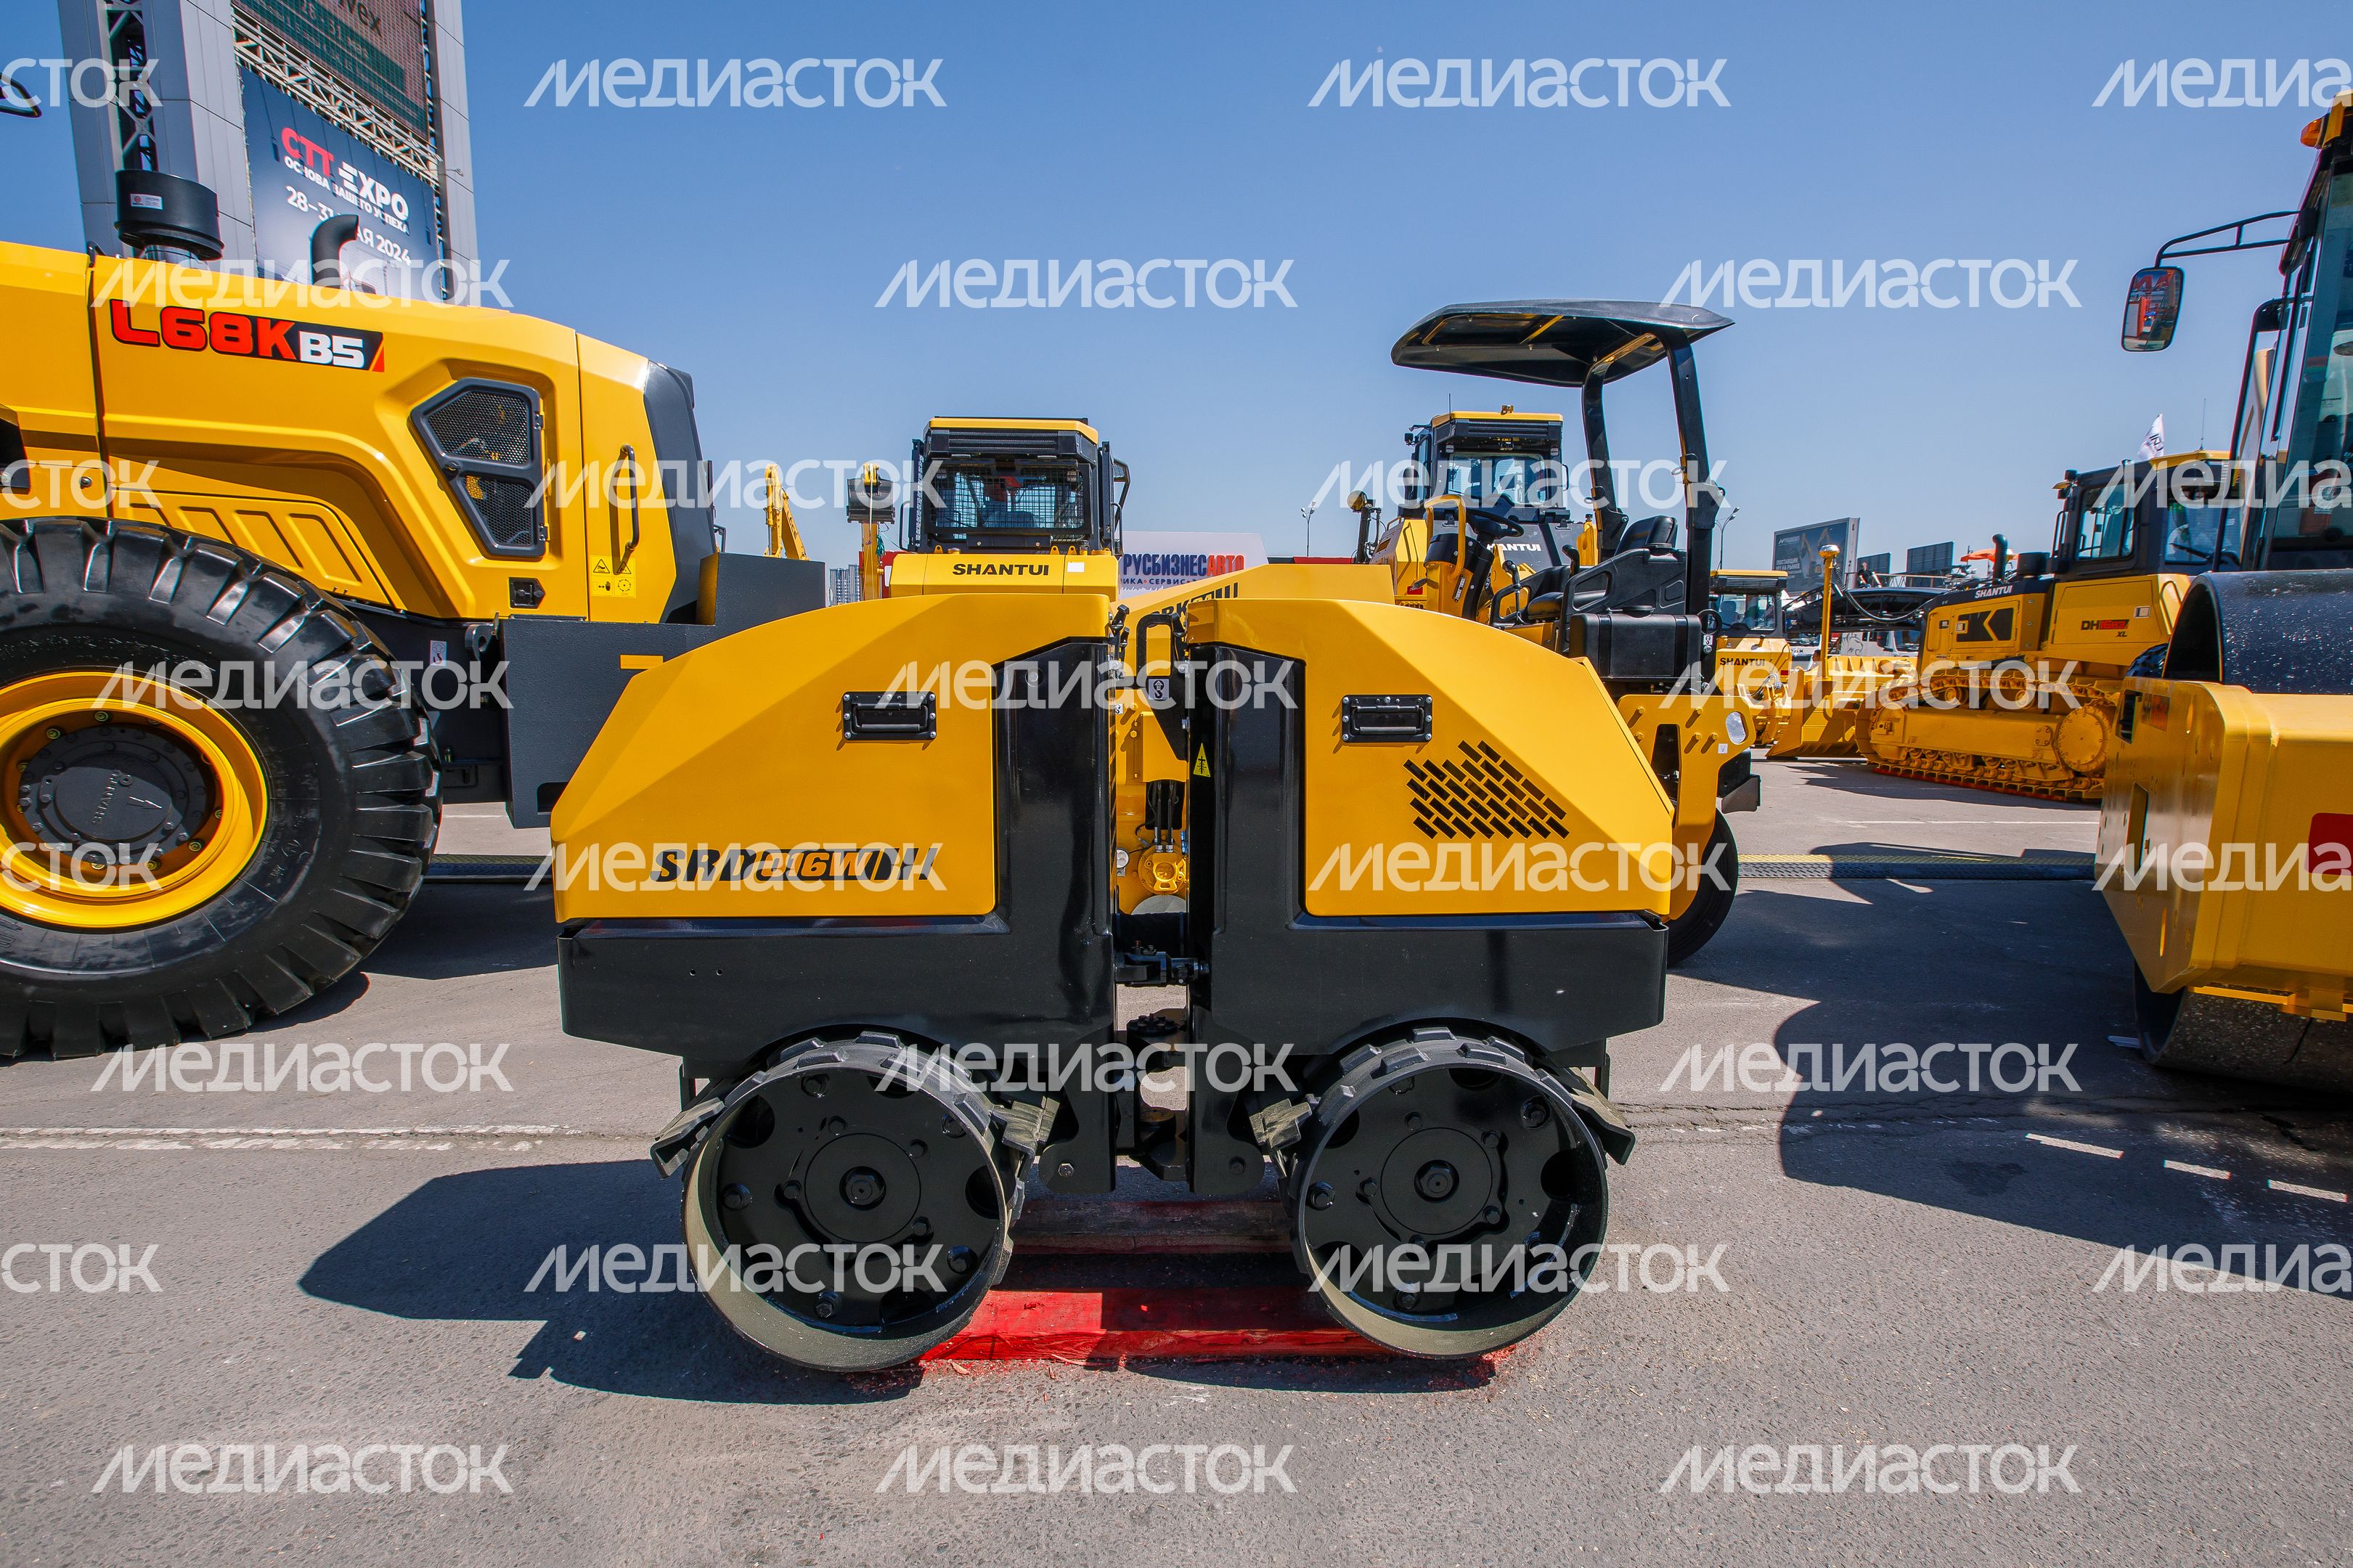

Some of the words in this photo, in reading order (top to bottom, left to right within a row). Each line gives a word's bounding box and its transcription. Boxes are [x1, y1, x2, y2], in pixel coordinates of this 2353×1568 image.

[338, 161, 409, 221] EXPO
[376, 234, 412, 266] 2024
[952, 563, 1049, 576] SHANTUI
[1975, 585, 2013, 599] SHANTUI
[1719, 657, 1766, 666] SHANTUI
